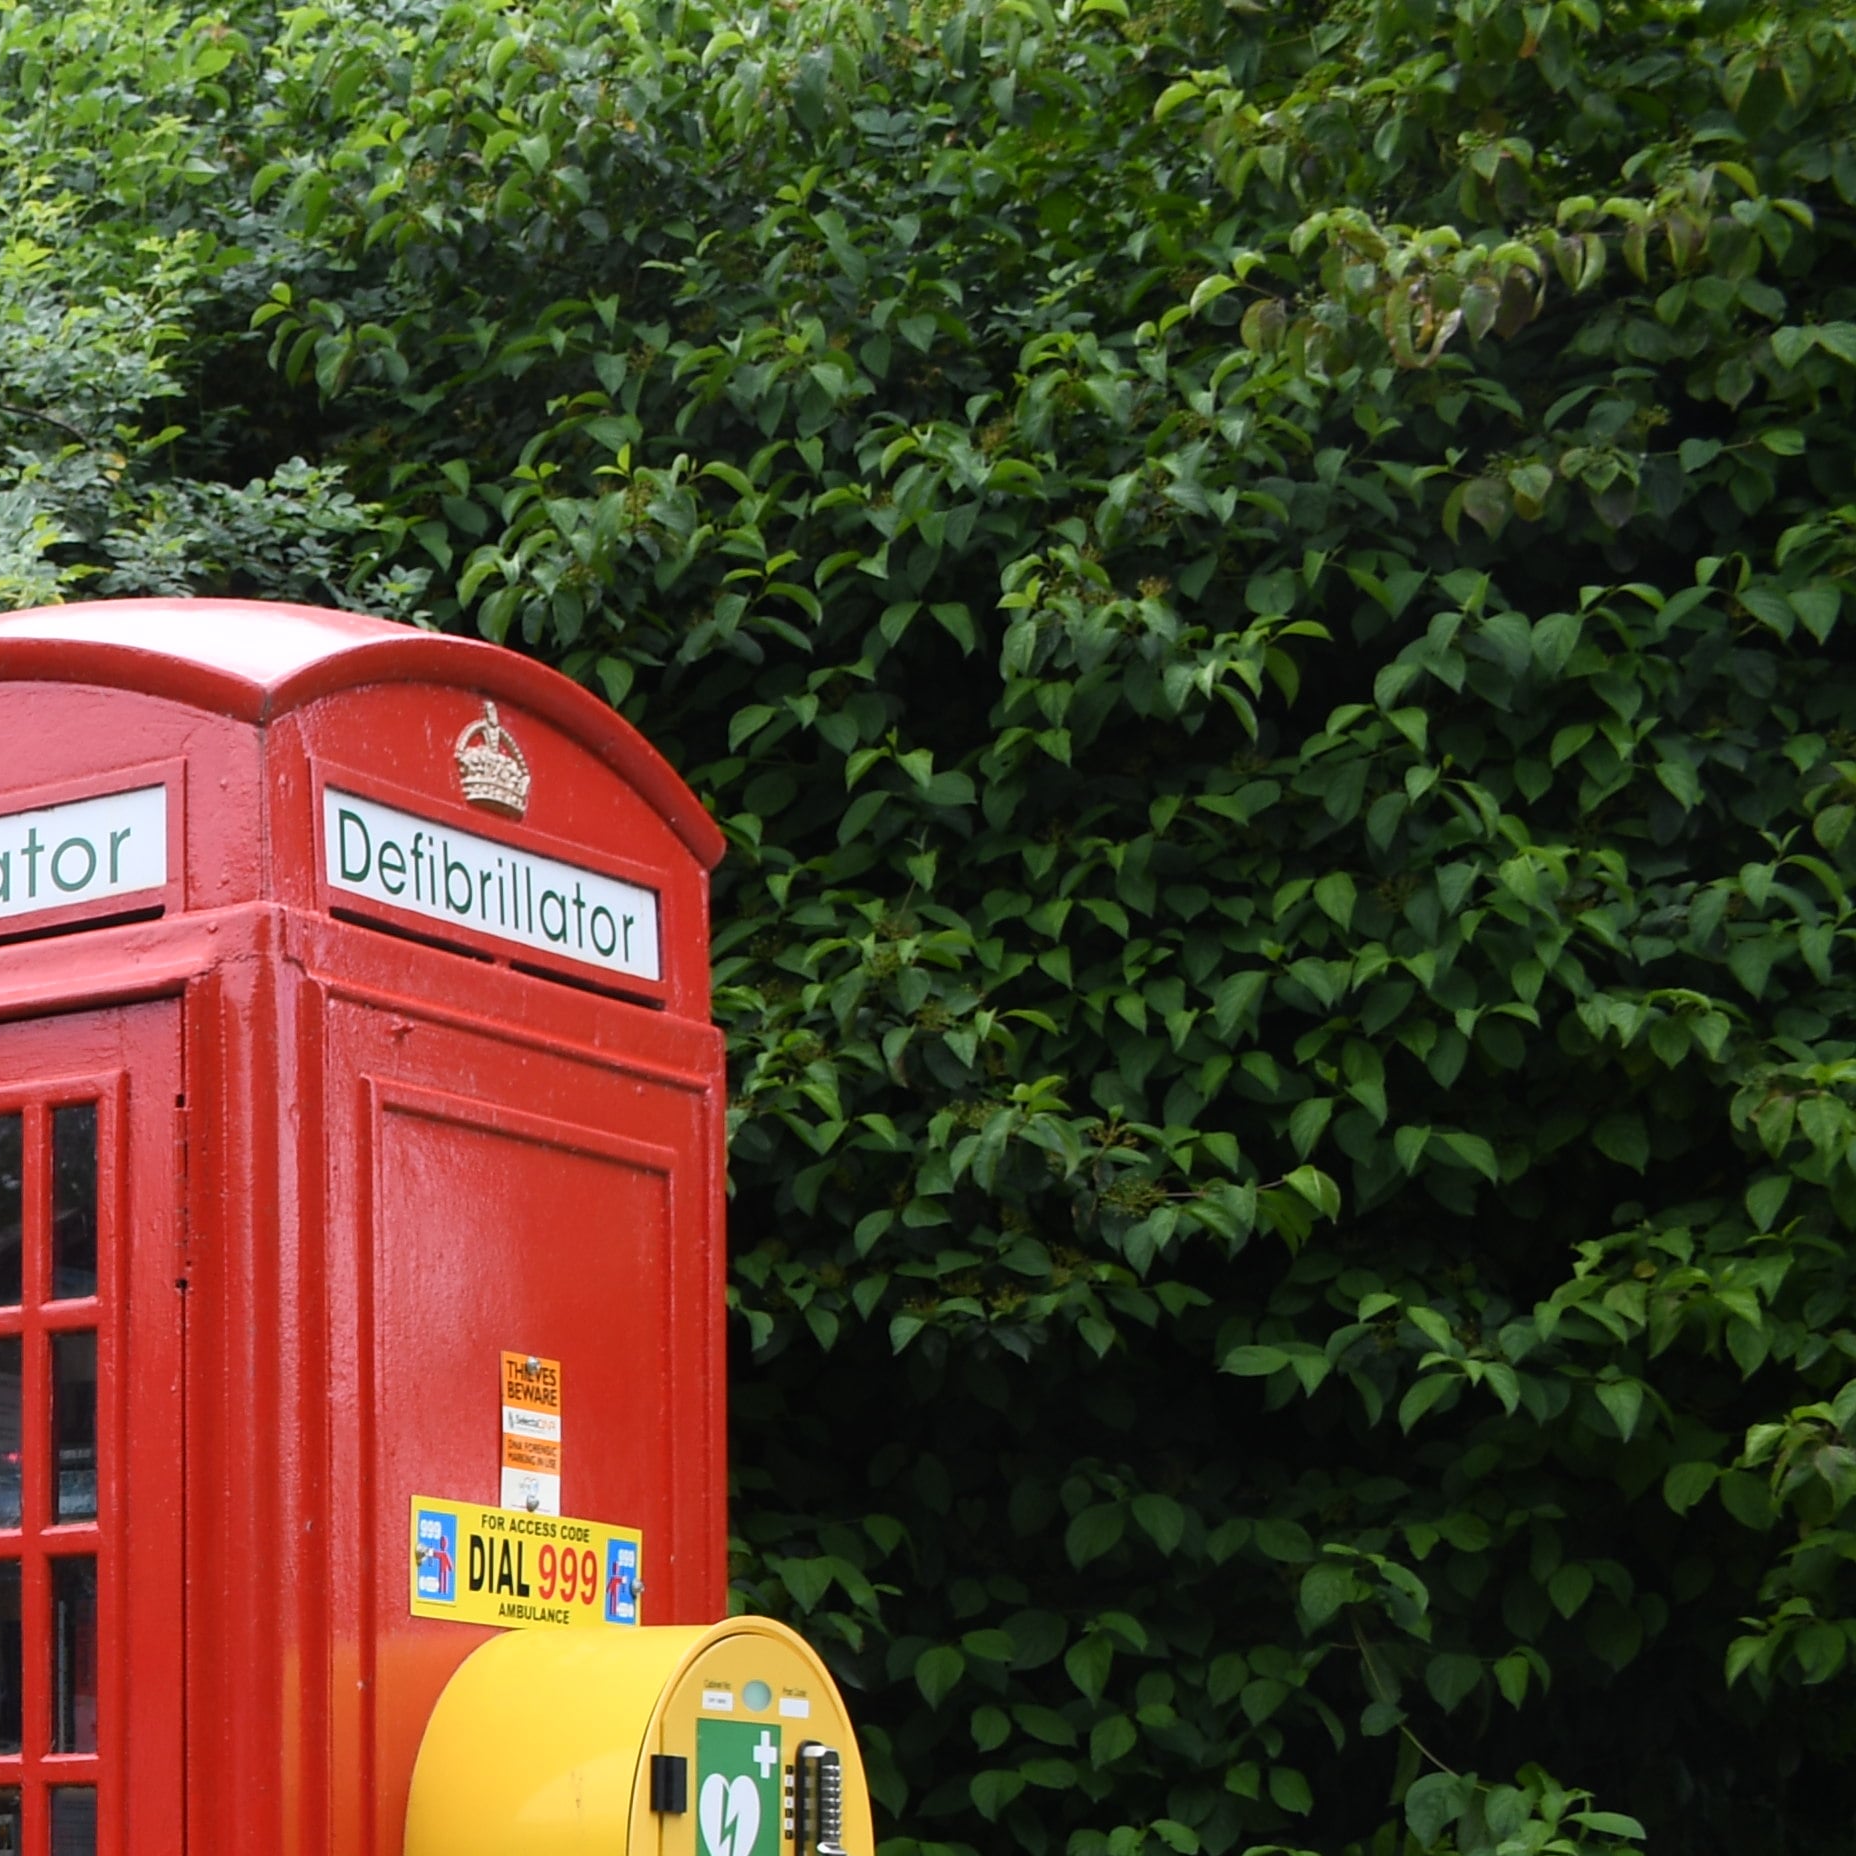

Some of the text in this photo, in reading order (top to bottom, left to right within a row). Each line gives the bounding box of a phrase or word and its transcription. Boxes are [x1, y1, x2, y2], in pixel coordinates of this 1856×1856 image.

[337, 807, 635, 962] Defibrillator
[507, 1380, 557, 1407] BEWARE
[508, 1439, 557, 1457] DNA FORENSIC
[481, 1513, 590, 1543] FOR ACCESS CODE
[469, 1534, 598, 1606] DIAL 999
[498, 1602, 570, 1625] AMBULANCE
